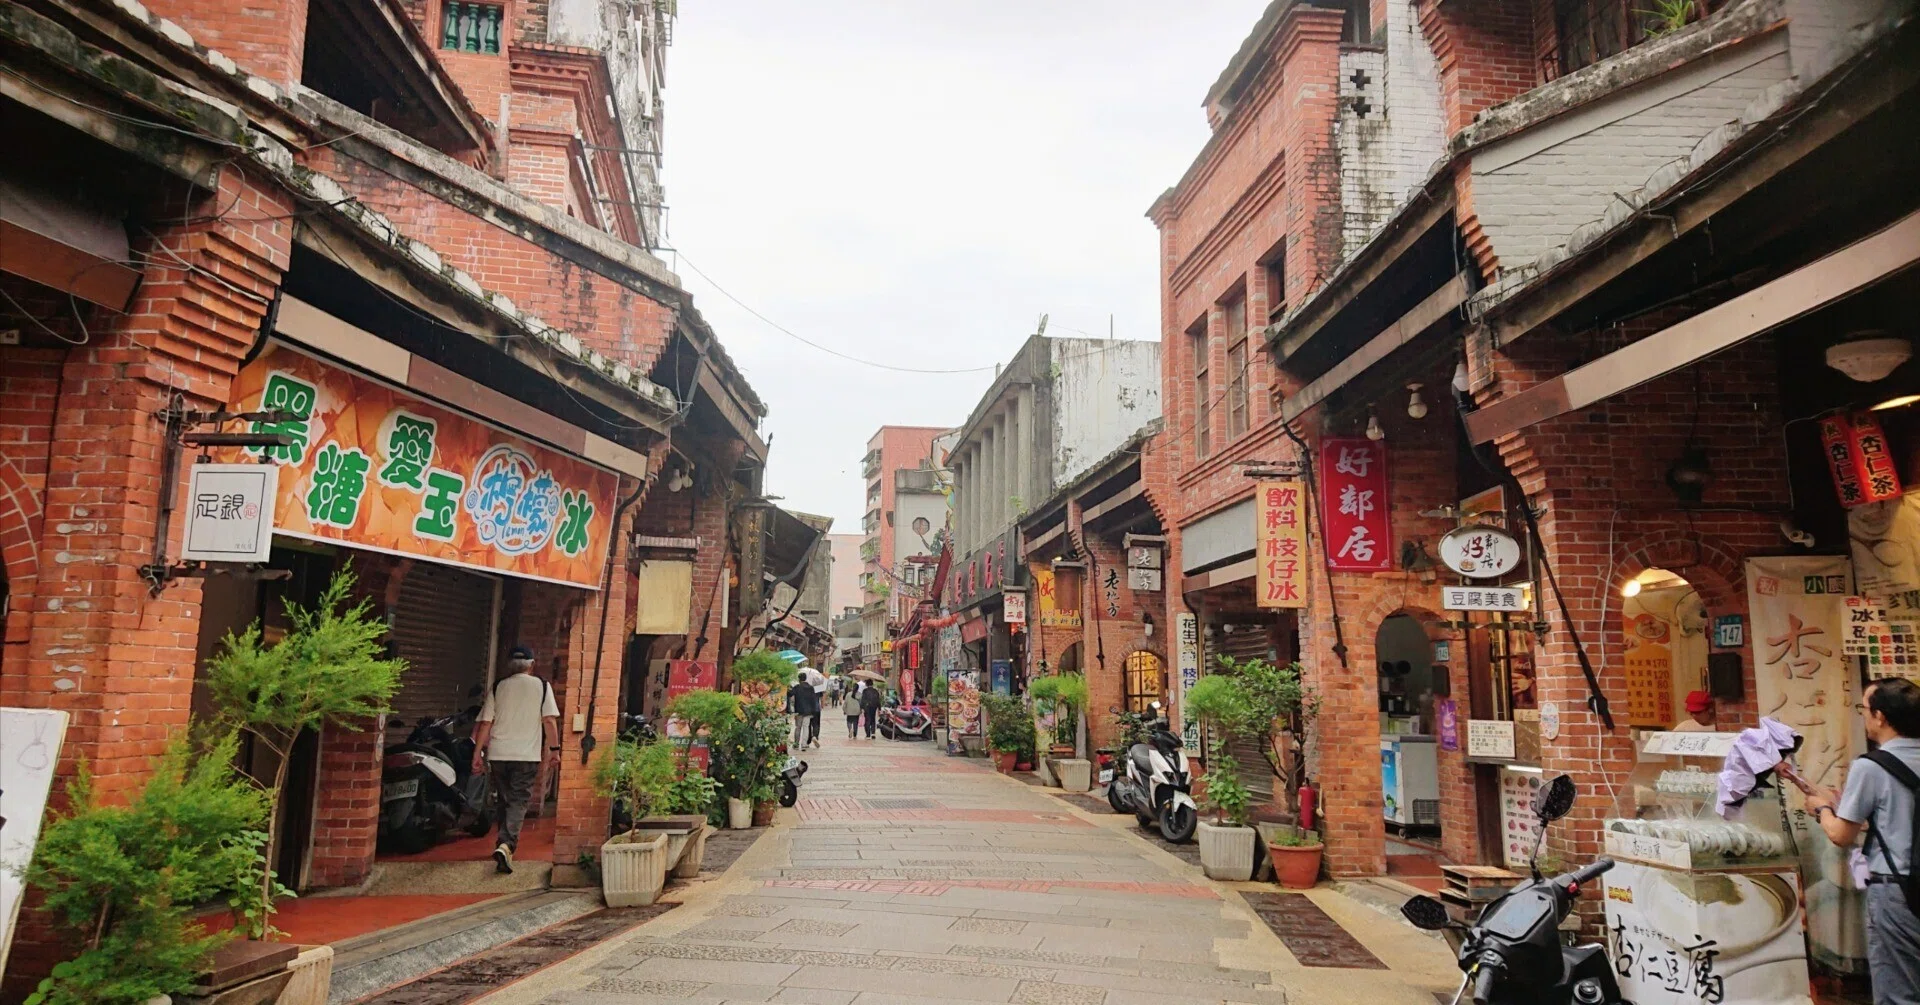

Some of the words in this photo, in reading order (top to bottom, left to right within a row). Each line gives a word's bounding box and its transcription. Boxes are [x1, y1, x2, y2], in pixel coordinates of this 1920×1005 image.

[1336, 446, 1376, 562] 好鄰居
[1104, 568, 1120, 617] 老地方
[1451, 591, 1517, 608] 豆腐美食
[1721, 626, 1740, 644] 147
[1612, 913, 1724, 1004] 杏仁豆腐
